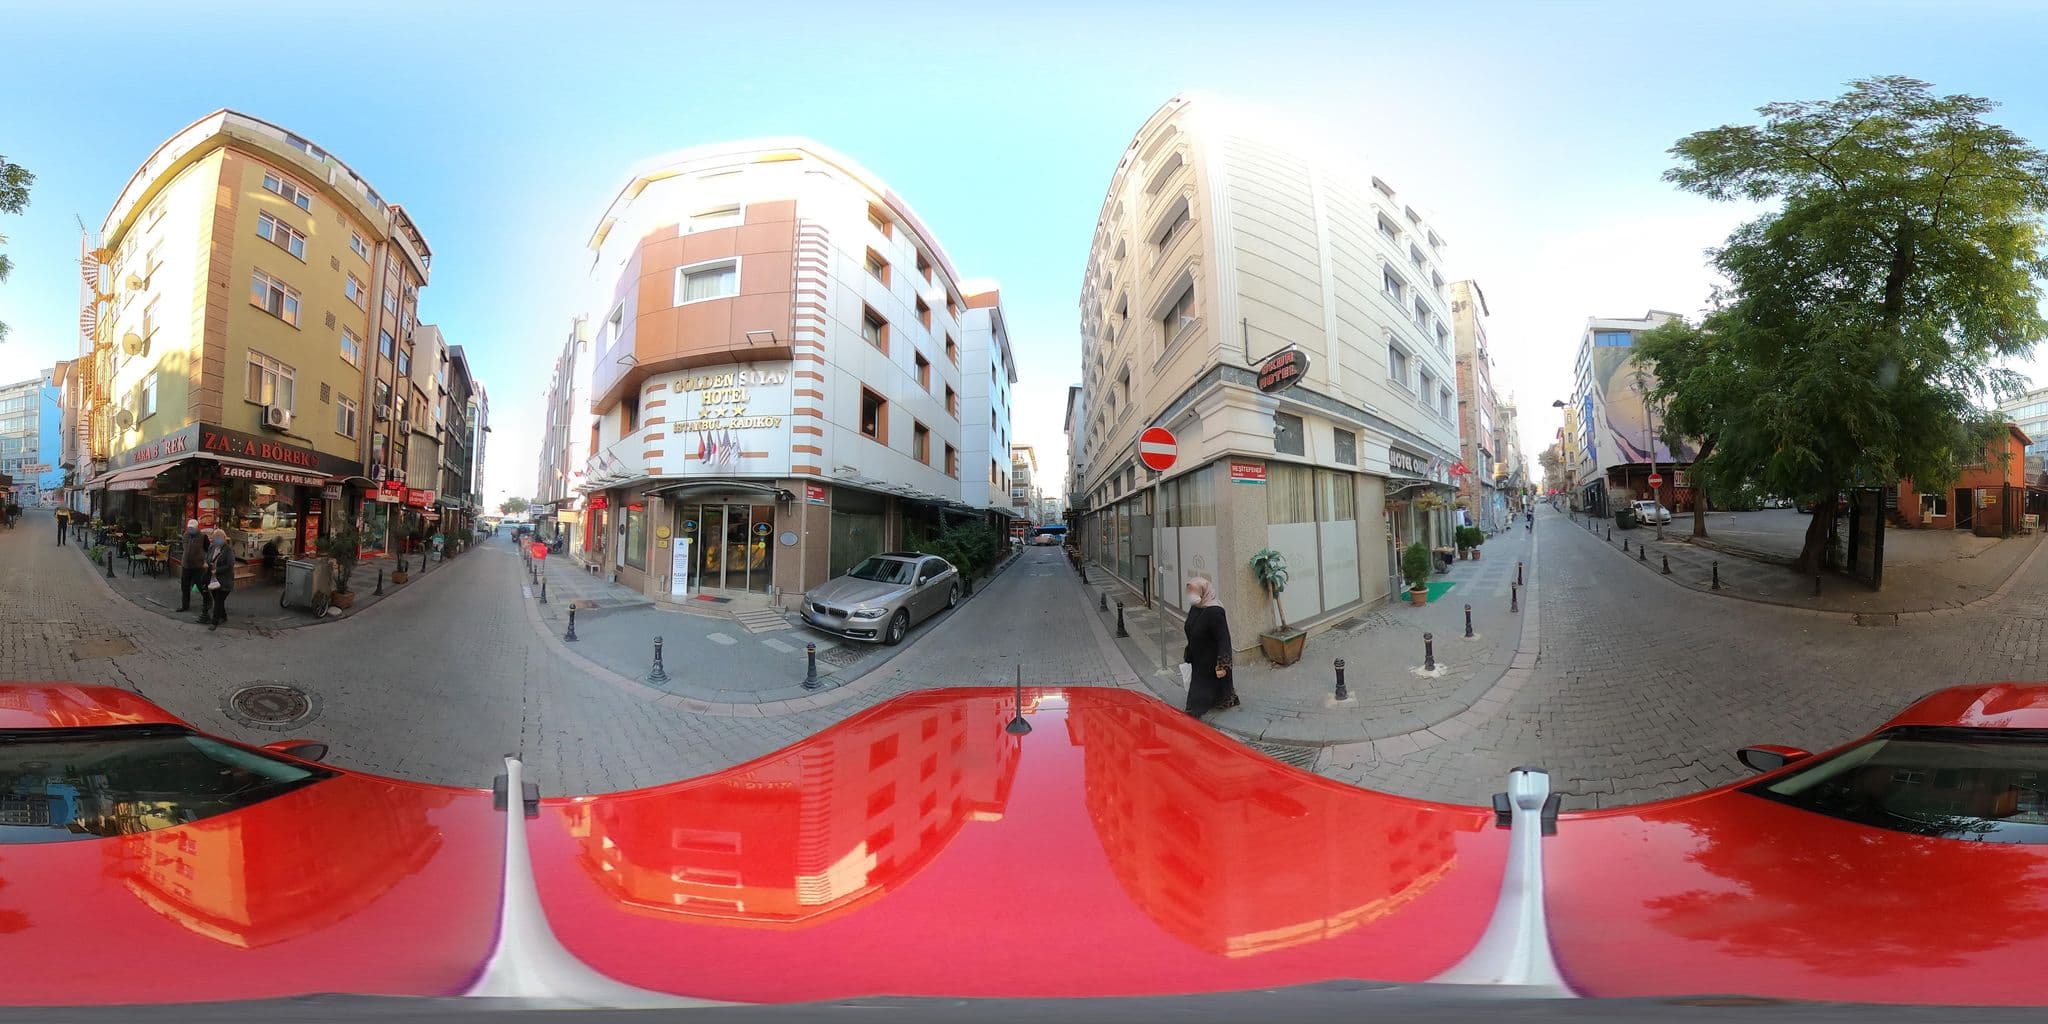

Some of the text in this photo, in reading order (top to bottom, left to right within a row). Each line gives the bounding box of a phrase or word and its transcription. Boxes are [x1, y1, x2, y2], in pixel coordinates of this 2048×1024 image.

[673, 373, 735, 393] GOLDEN
[702, 387, 751, 406] HOTEL
[154, 435, 187, 458] BREK
[204, 431, 311, 466] ZAA BÖREK
[223, 467, 252, 478] ZARA
[255, 470, 284, 482] BÖREK
